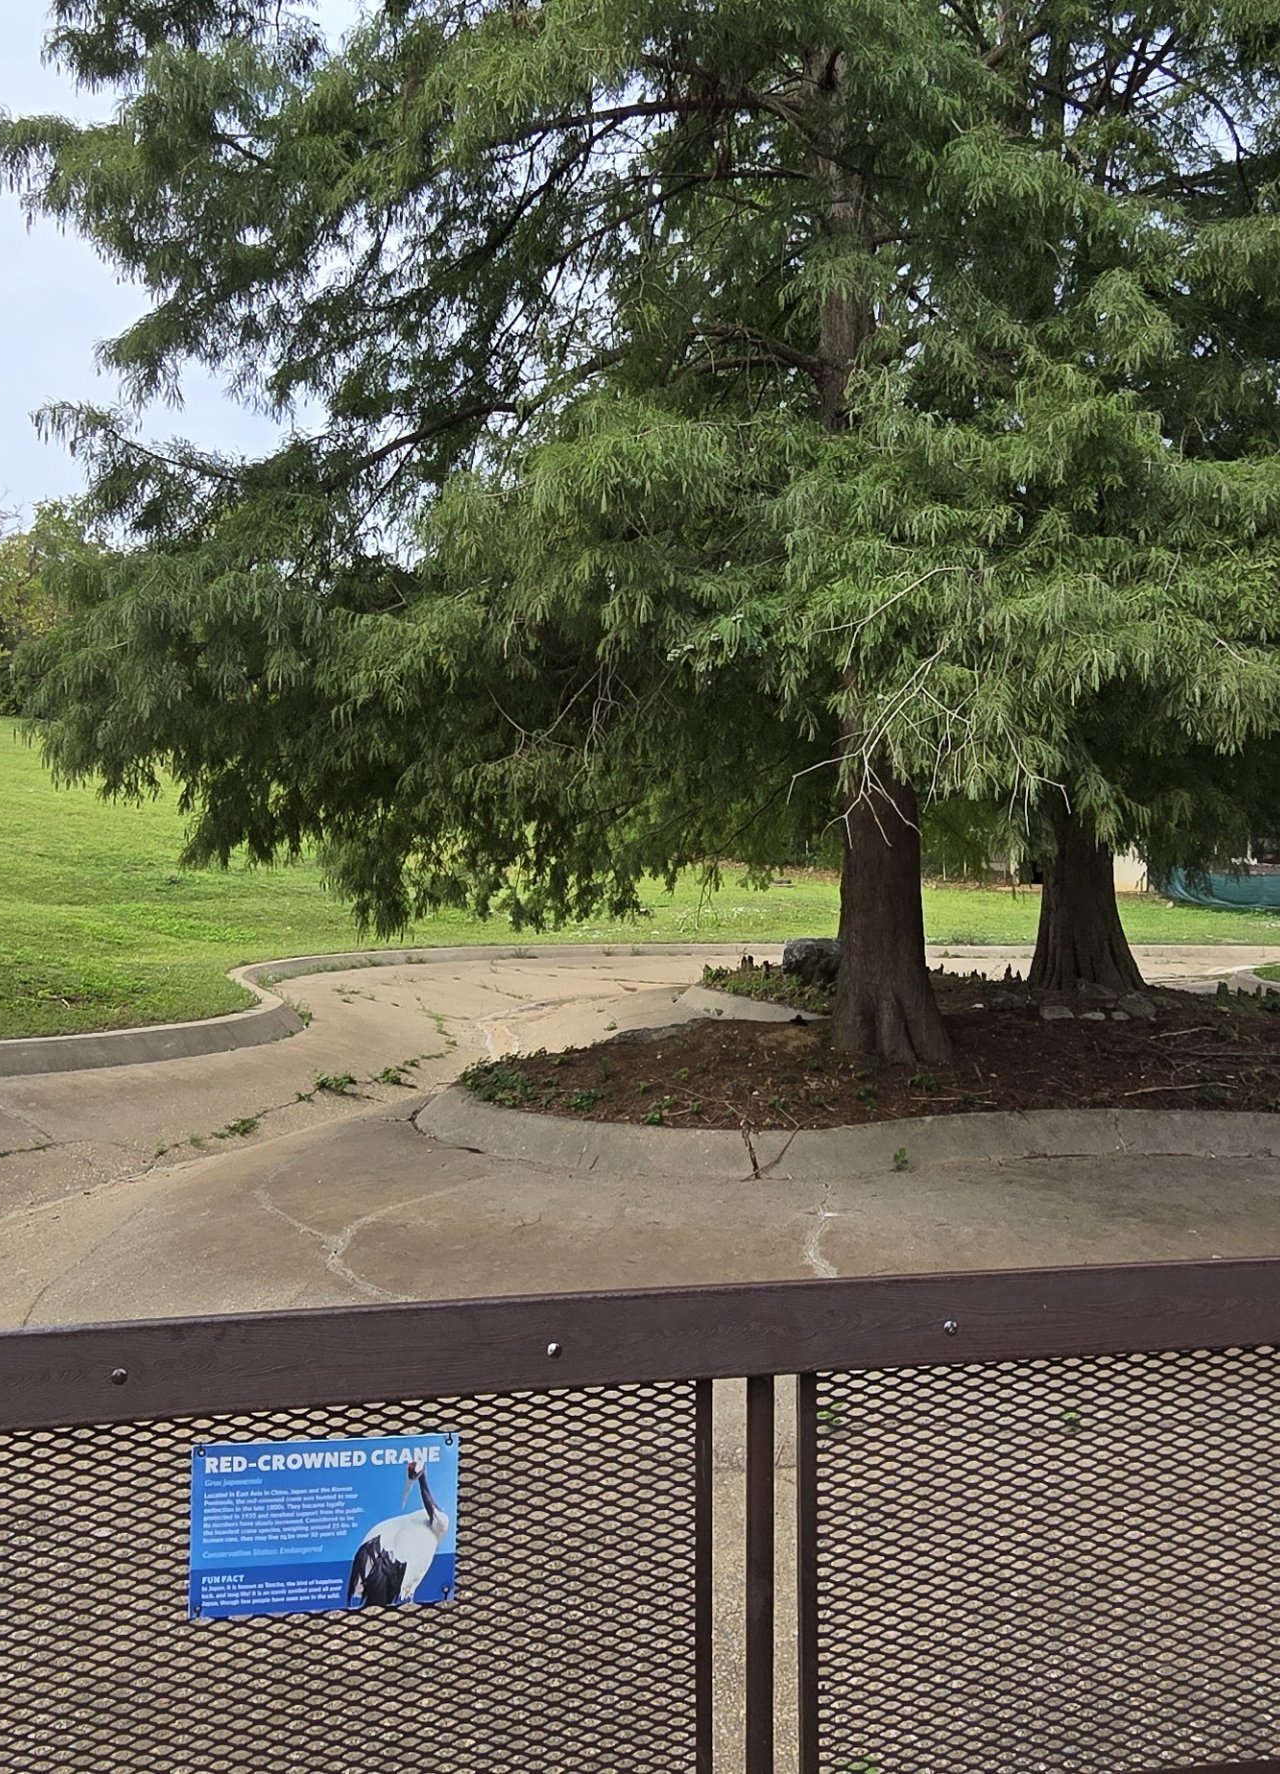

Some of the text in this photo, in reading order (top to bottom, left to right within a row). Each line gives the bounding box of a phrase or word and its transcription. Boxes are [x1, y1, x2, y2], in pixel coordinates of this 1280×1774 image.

[204, 1447, 440, 1474] RED-CROWNED CRANE
[202, 1574, 244, 1584] FUN FACT
